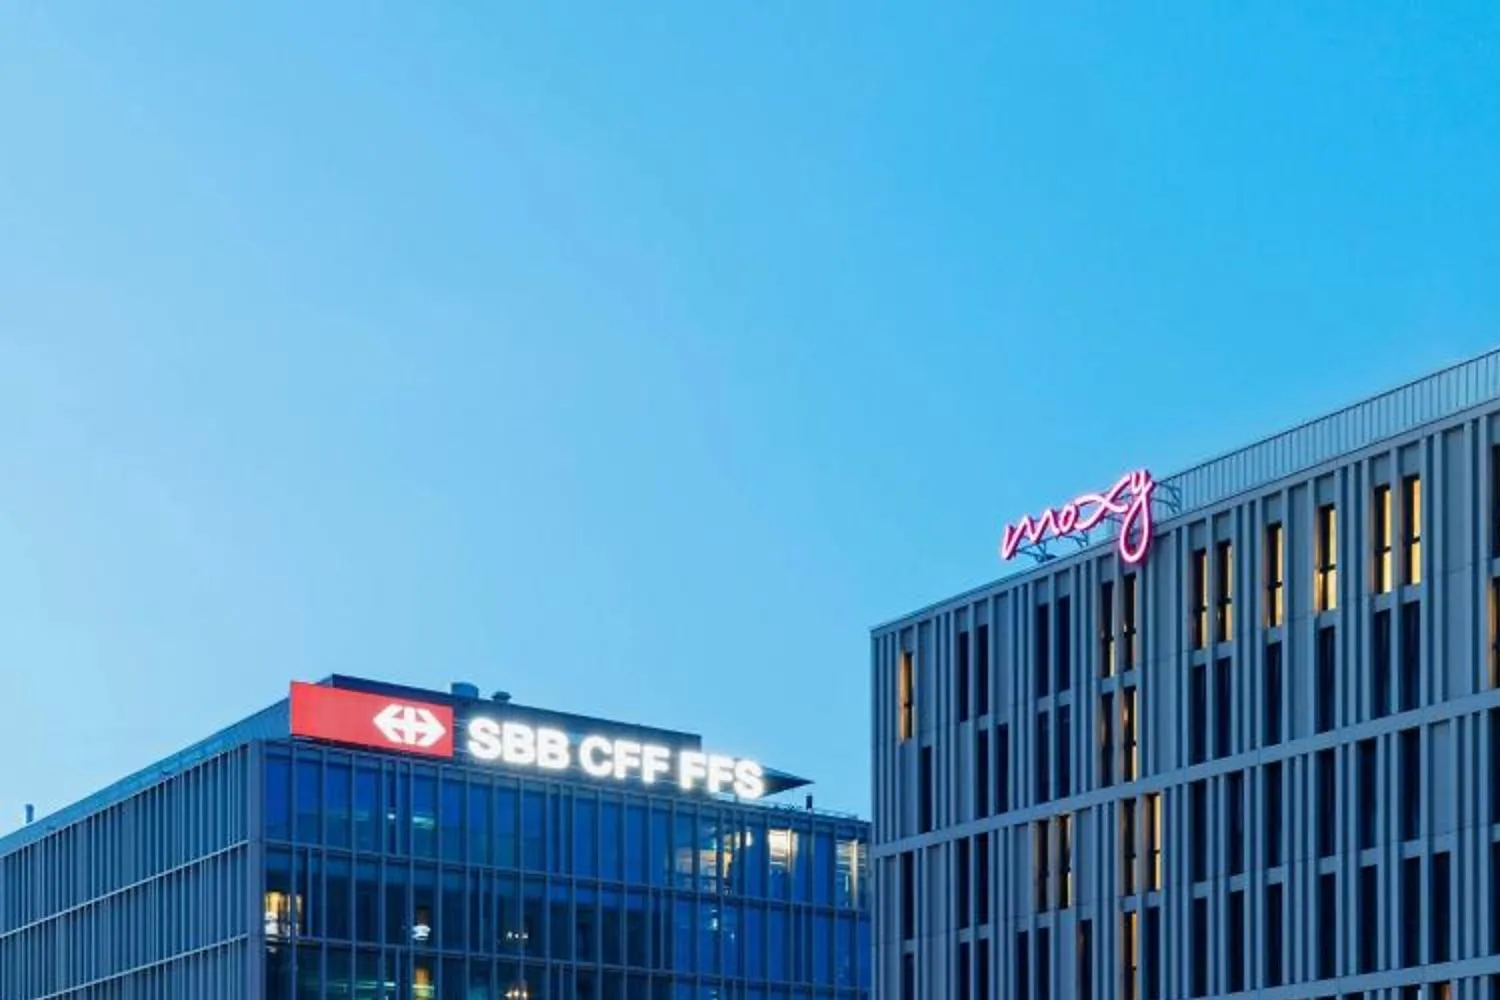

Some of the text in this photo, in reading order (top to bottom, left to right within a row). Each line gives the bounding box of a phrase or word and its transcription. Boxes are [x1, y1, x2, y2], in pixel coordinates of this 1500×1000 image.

[1001, 469, 1155, 563] moxy
[467, 717, 765, 800] SBB CFF FFS
